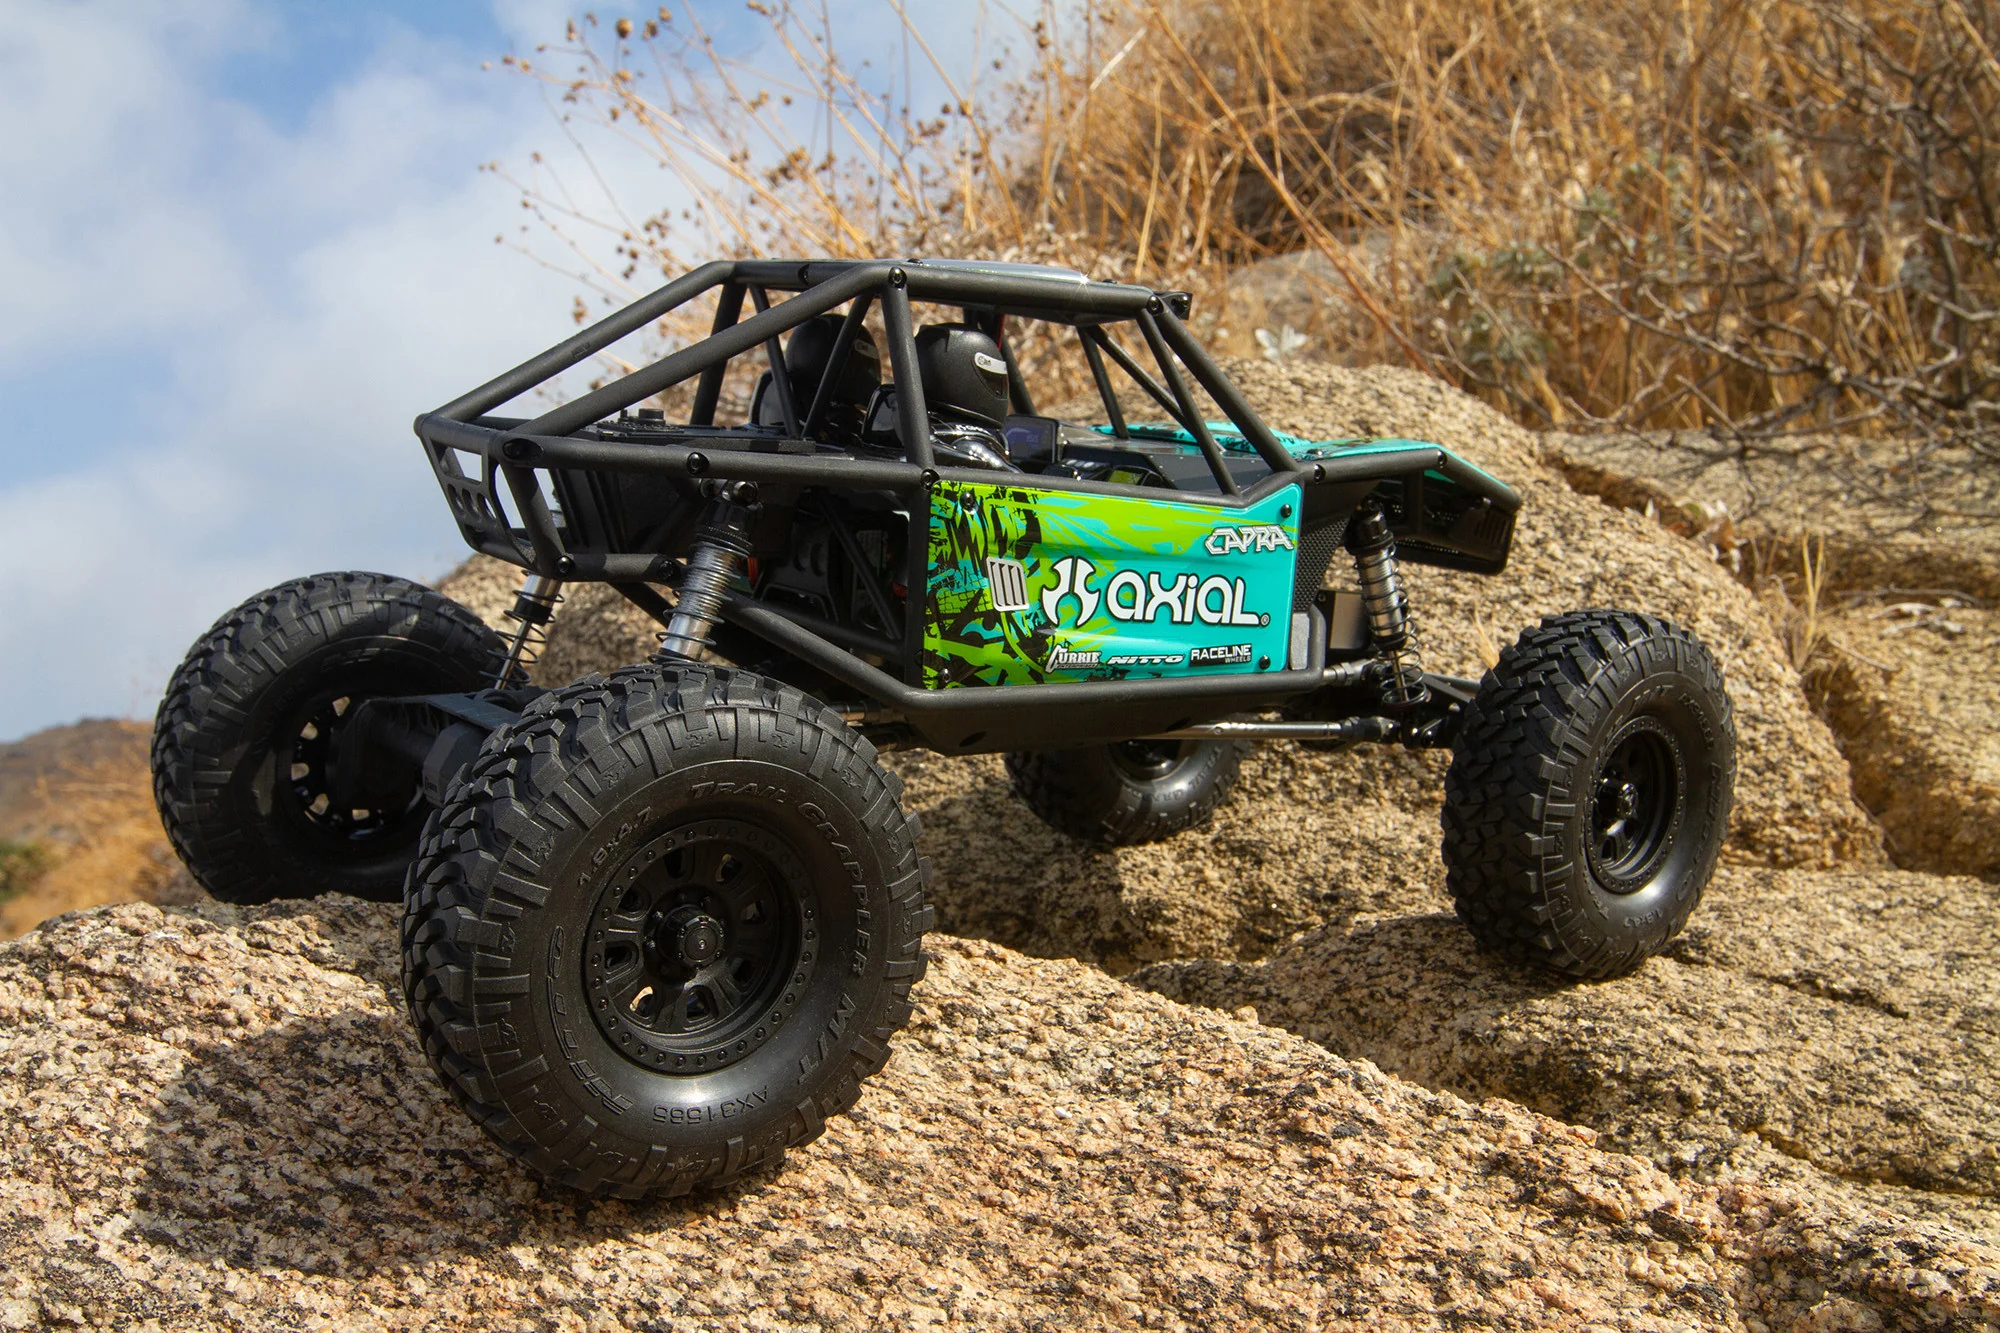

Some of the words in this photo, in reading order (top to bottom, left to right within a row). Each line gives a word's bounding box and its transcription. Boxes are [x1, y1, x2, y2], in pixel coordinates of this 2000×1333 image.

[1205, 524, 1294, 555] CAPRA
[1045, 645, 1102, 674] CURRIE
[1107, 655, 1185, 665] NITTO
[1190, 644, 1252, 661] RACELINE
[1224, 655, 1252, 663] WHEELS
[690, 780, 787, 804] TRAIL
[798, 801, 872, 977] GRAPPLER
